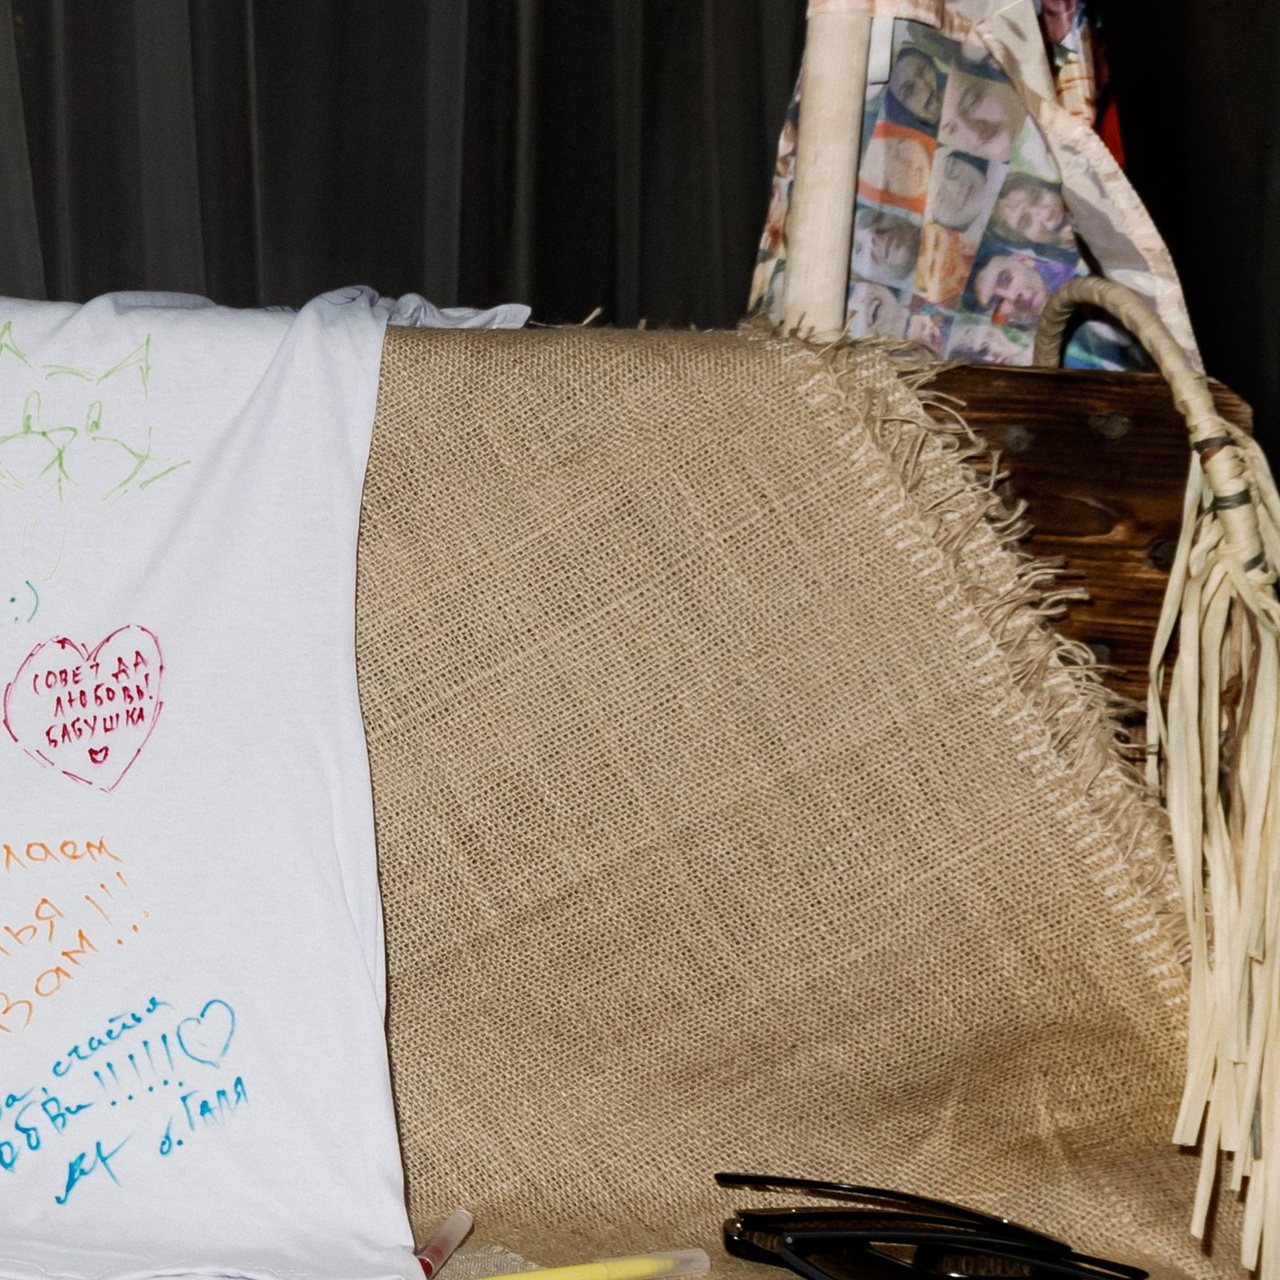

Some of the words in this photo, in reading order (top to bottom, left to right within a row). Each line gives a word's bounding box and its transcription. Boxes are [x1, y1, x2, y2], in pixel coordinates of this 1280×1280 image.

[32, 662, 101, 697] СОВЕТ
[110, 650, 148, 684] ДА
[54, 673, 154, 718] ЛЮБОВЬ!
[45, 706, 146, 748] БАБУШКА
